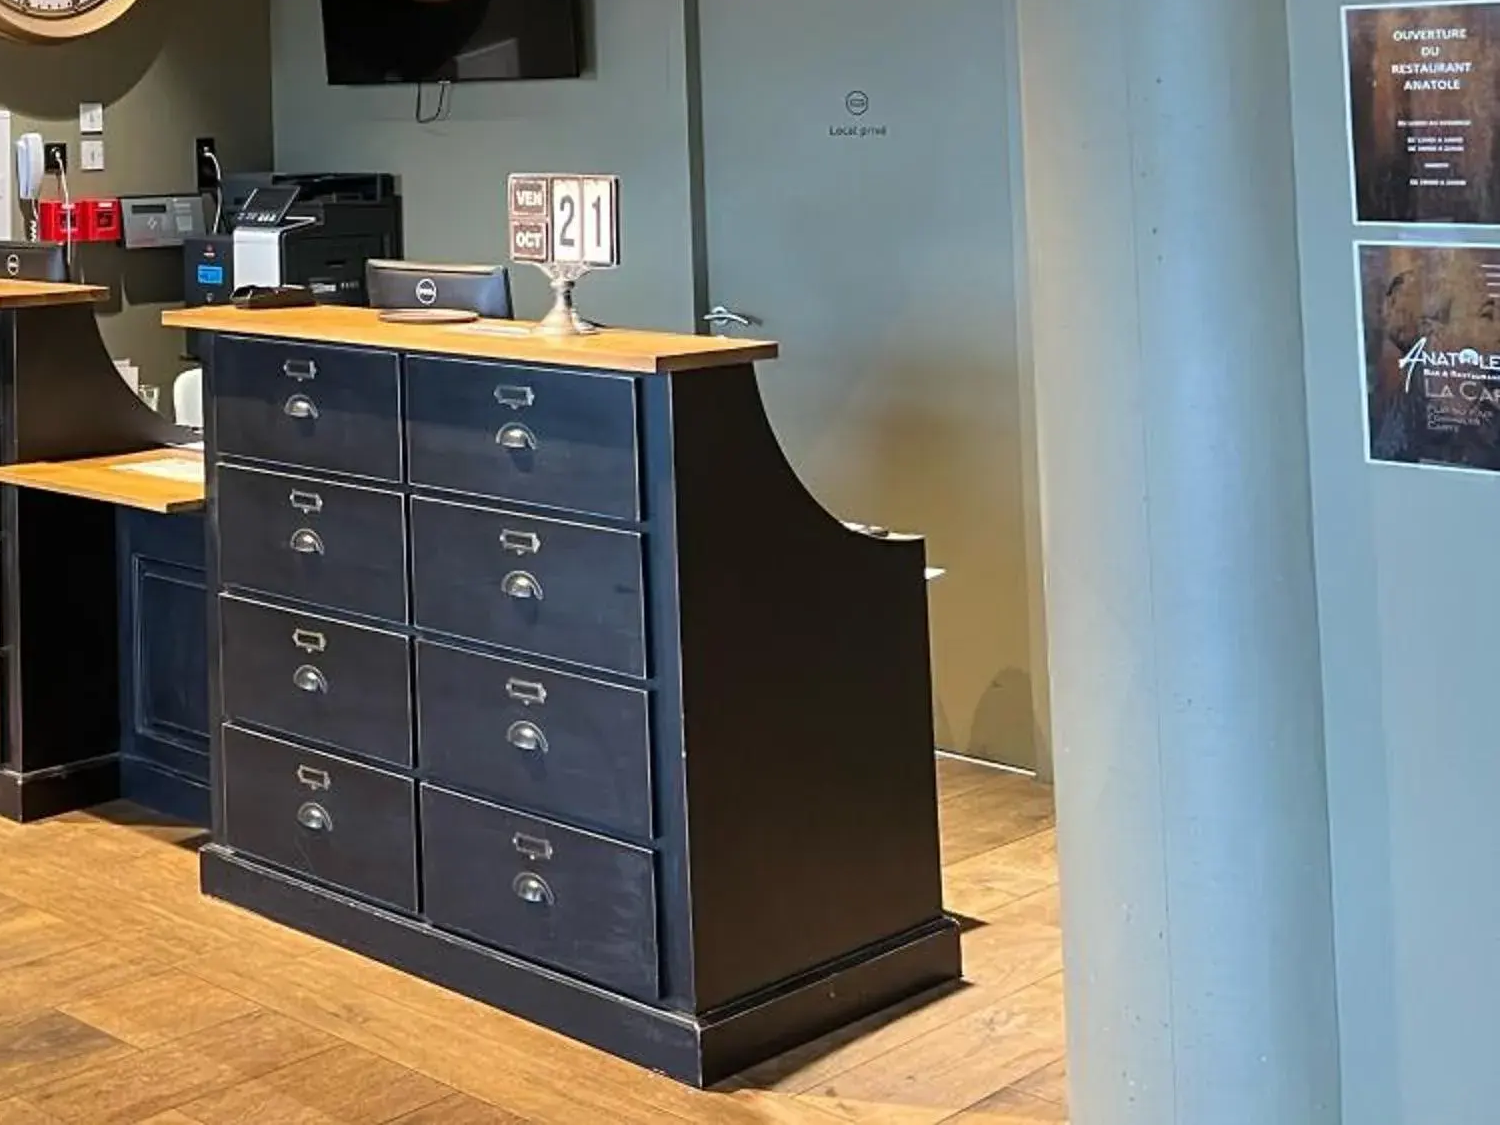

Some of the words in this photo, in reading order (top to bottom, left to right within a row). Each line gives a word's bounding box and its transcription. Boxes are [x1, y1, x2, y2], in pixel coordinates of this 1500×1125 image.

[1393, 28, 1467, 41] OUVERTURE
[1420, 46, 1441, 57] DU
[1391, 62, 1472, 75] RESTAURANT
[1403, 79, 1461, 91] ANATOLE
[515, 231, 542, 248] OCT
